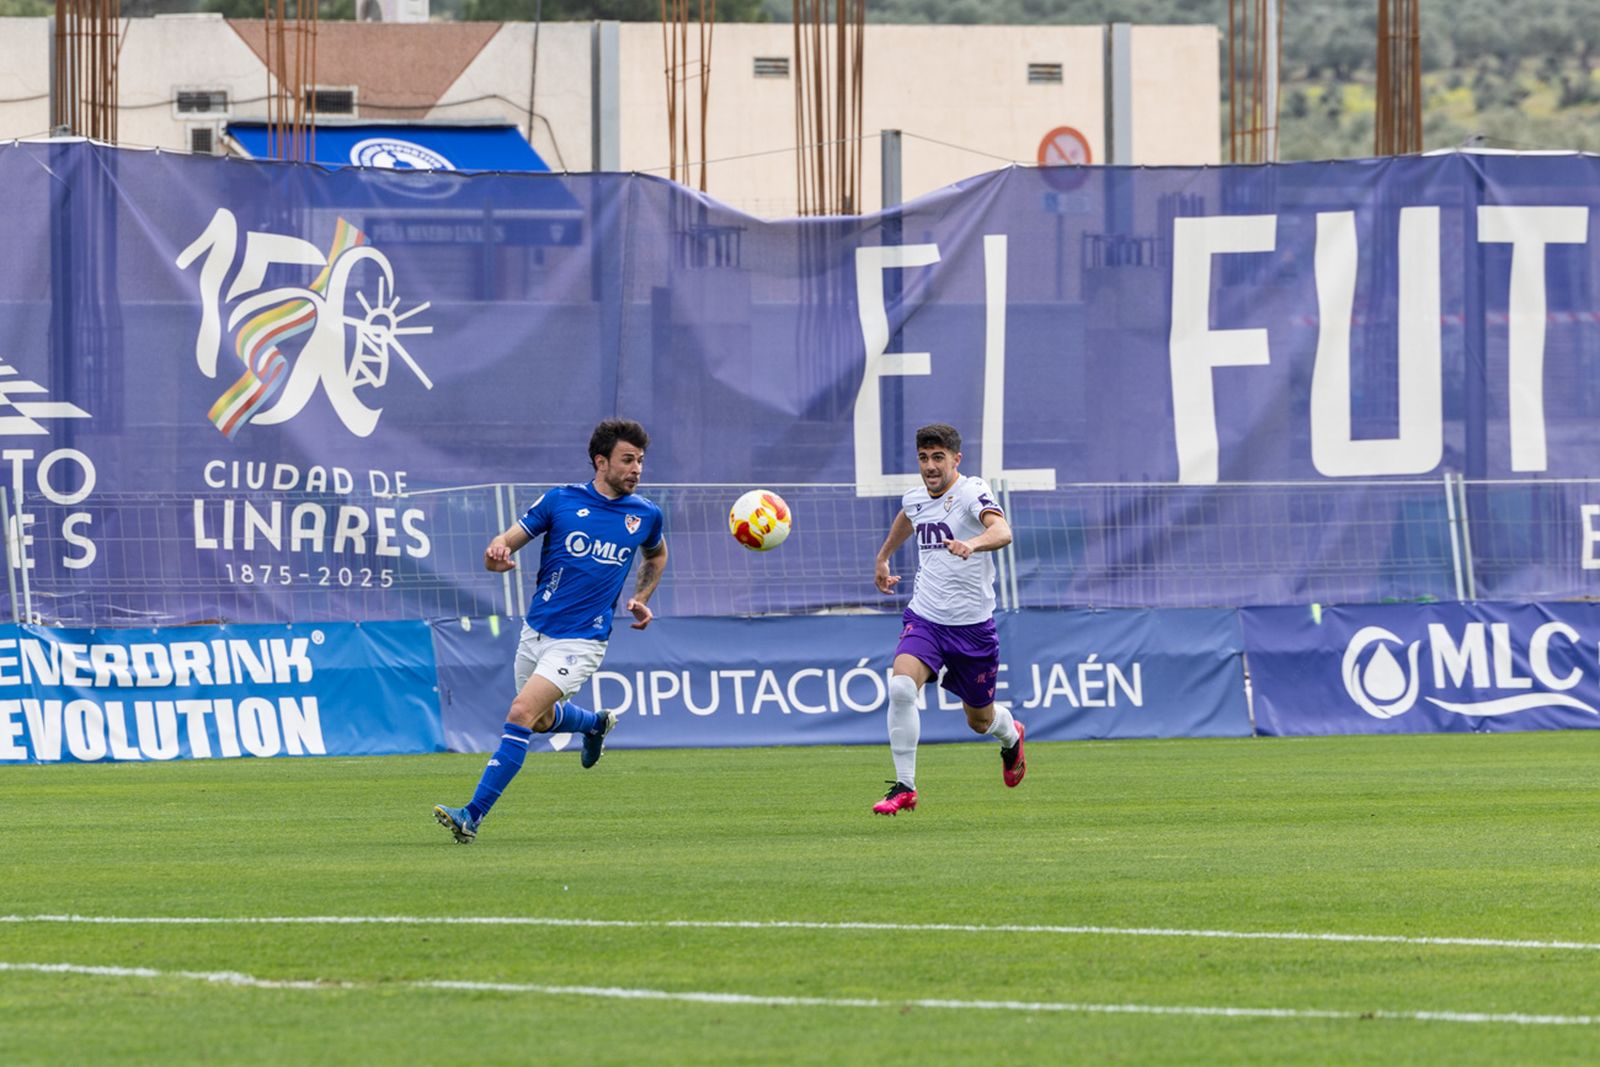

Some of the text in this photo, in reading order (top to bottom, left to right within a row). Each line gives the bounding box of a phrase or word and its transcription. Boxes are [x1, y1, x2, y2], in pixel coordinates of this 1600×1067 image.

[854, 206, 1589, 498] EL FUT
[3, 448, 97, 505] TO
[203, 460, 409, 499] CIUDAD DE
[193, 499, 432, 559] LINARES
[592, 540, 632, 562] MLC
[225, 564, 394, 588] 1875-2025
[1022, 653, 1143, 709] JAÉN
[1428, 621, 1584, 690] MLC
[0, 696, 327, 761] EVOLUTION
